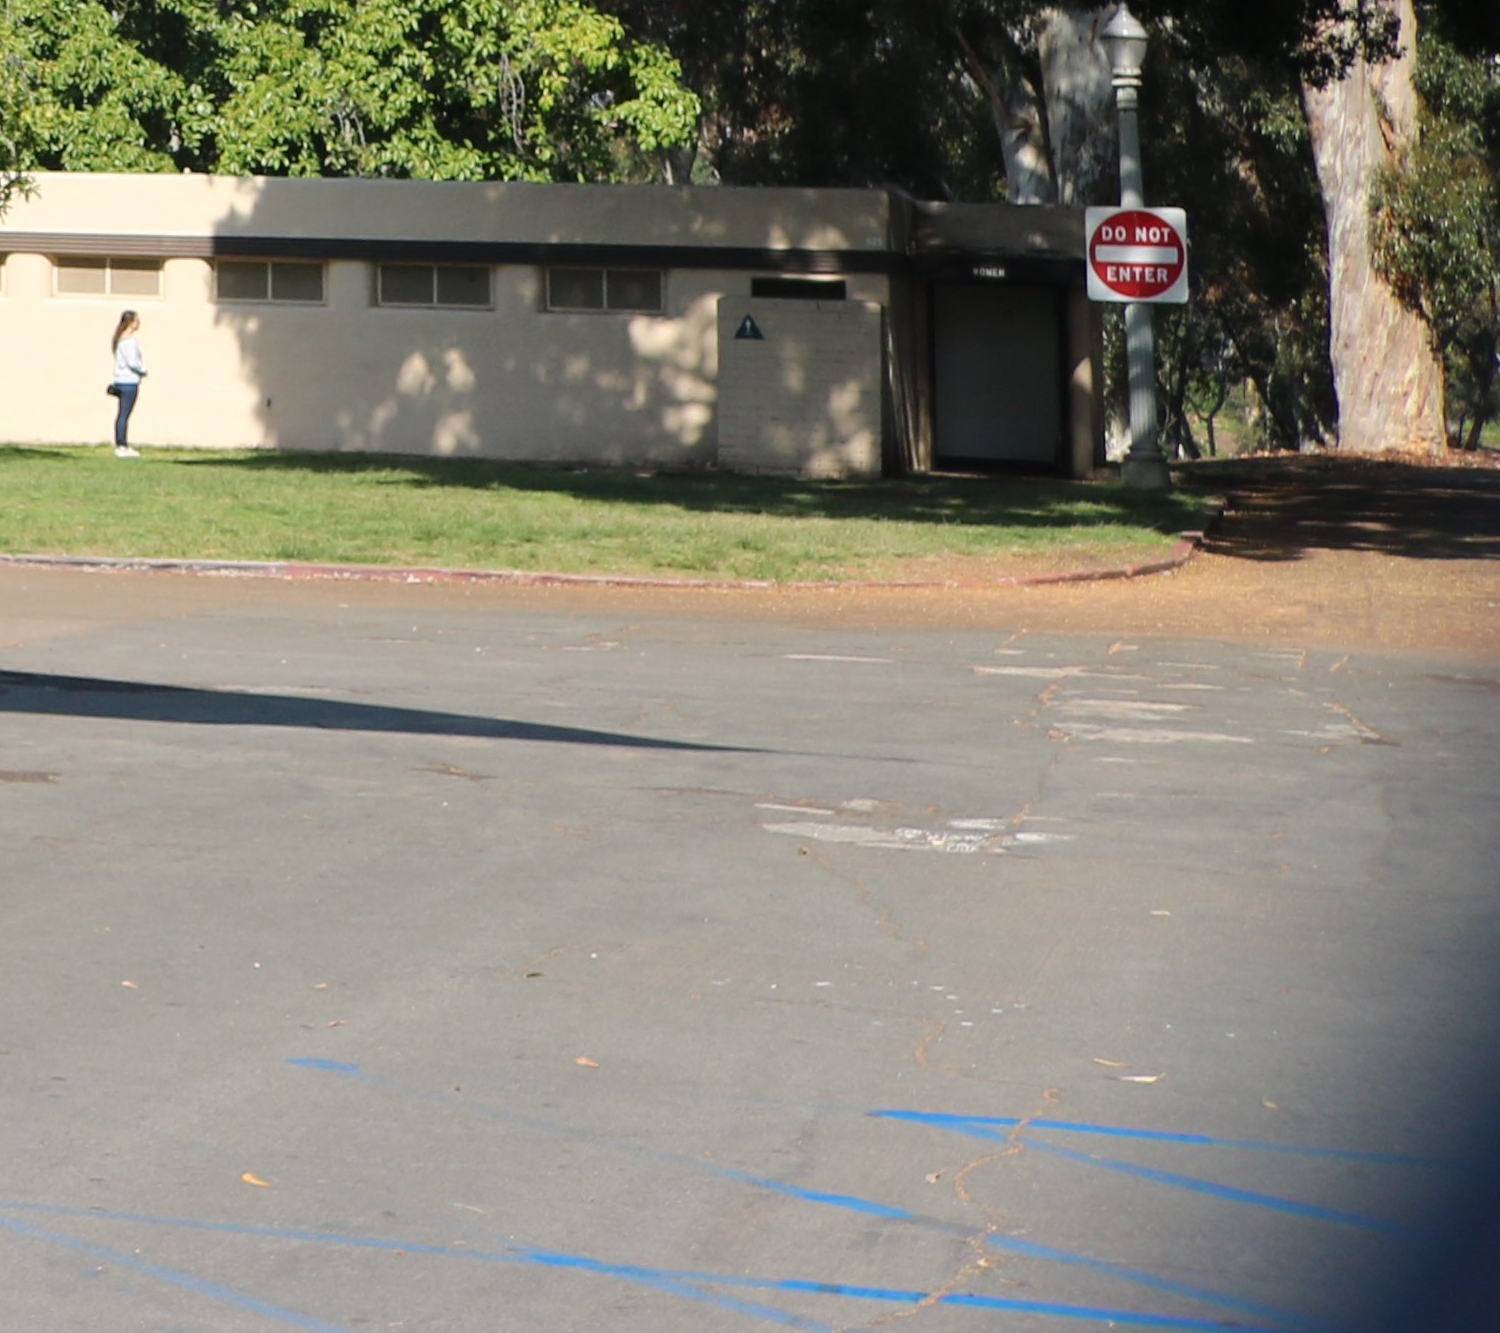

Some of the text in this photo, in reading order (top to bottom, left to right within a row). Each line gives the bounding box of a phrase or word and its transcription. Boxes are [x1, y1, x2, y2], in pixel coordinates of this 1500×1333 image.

[1102, 226, 1171, 243] DO NOT
[1107, 265, 1168, 283] ENTER
